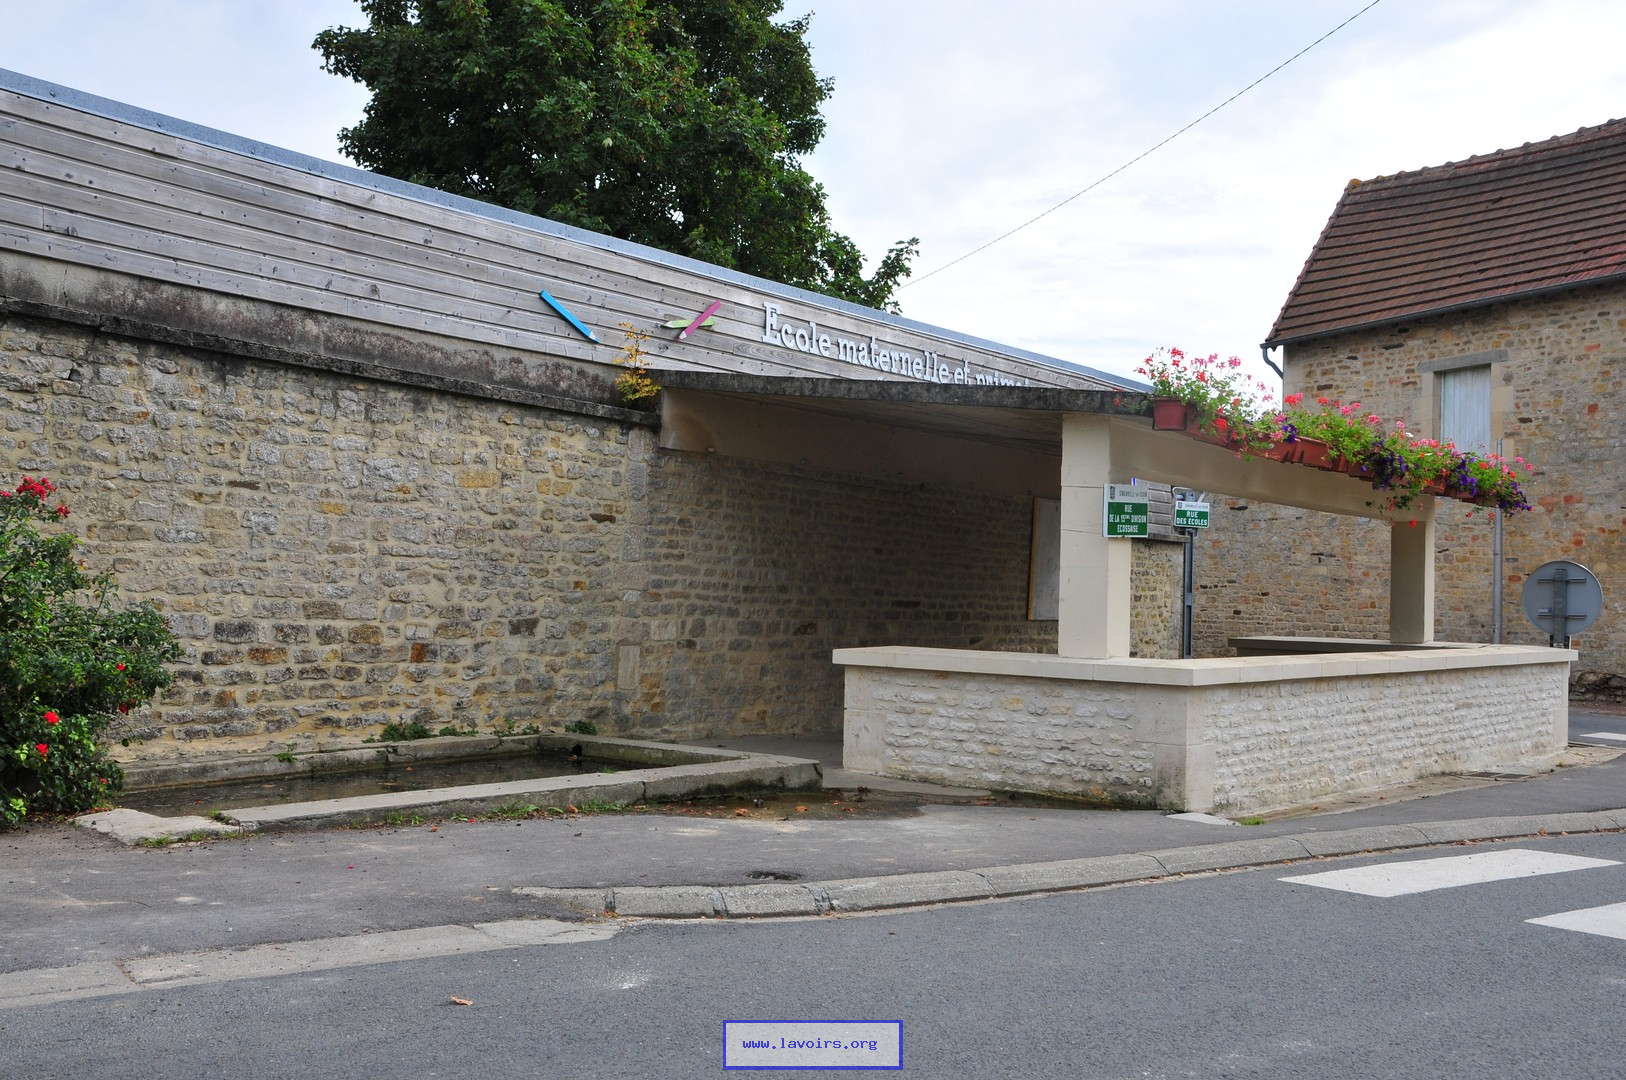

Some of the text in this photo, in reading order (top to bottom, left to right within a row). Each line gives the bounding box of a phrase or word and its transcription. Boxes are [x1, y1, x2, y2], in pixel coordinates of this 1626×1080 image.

[762, 301, 831, 357] Ecole
[836, 335, 949, 384] maternelle
[954, 358, 971, 385] et
[1124, 504, 1133, 513] RUE
[1109, 514, 1114, 523] DE
[1114, 514, 1120, 523] LA
[1131, 514, 1147, 523] DIVISION
[1186, 510, 1199, 518] RUE
[1176, 517, 1208, 526] DES ÉCOLES
[1117, 524, 1139, 533] ECOSSAISE
